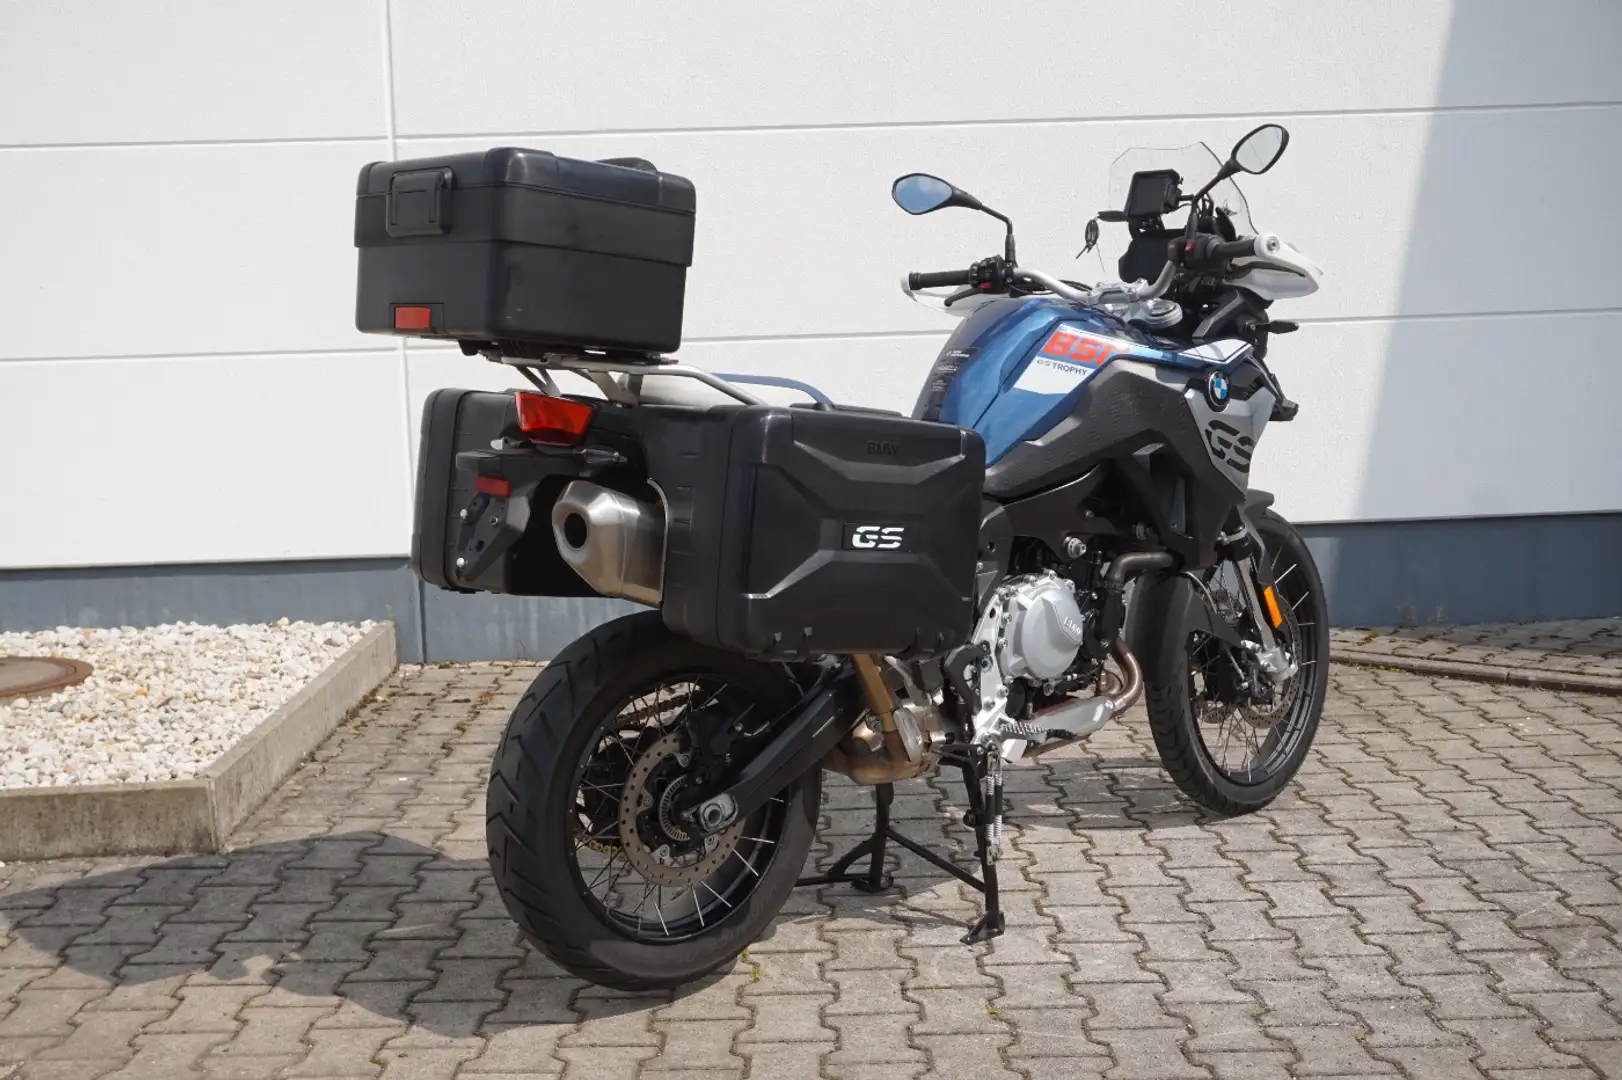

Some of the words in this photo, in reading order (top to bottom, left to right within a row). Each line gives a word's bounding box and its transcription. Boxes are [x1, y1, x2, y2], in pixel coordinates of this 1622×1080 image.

[1052, 361, 1088, 376] TROPHY
[867, 440, 900, 457] BMW
[851, 526, 905, 549] GS
